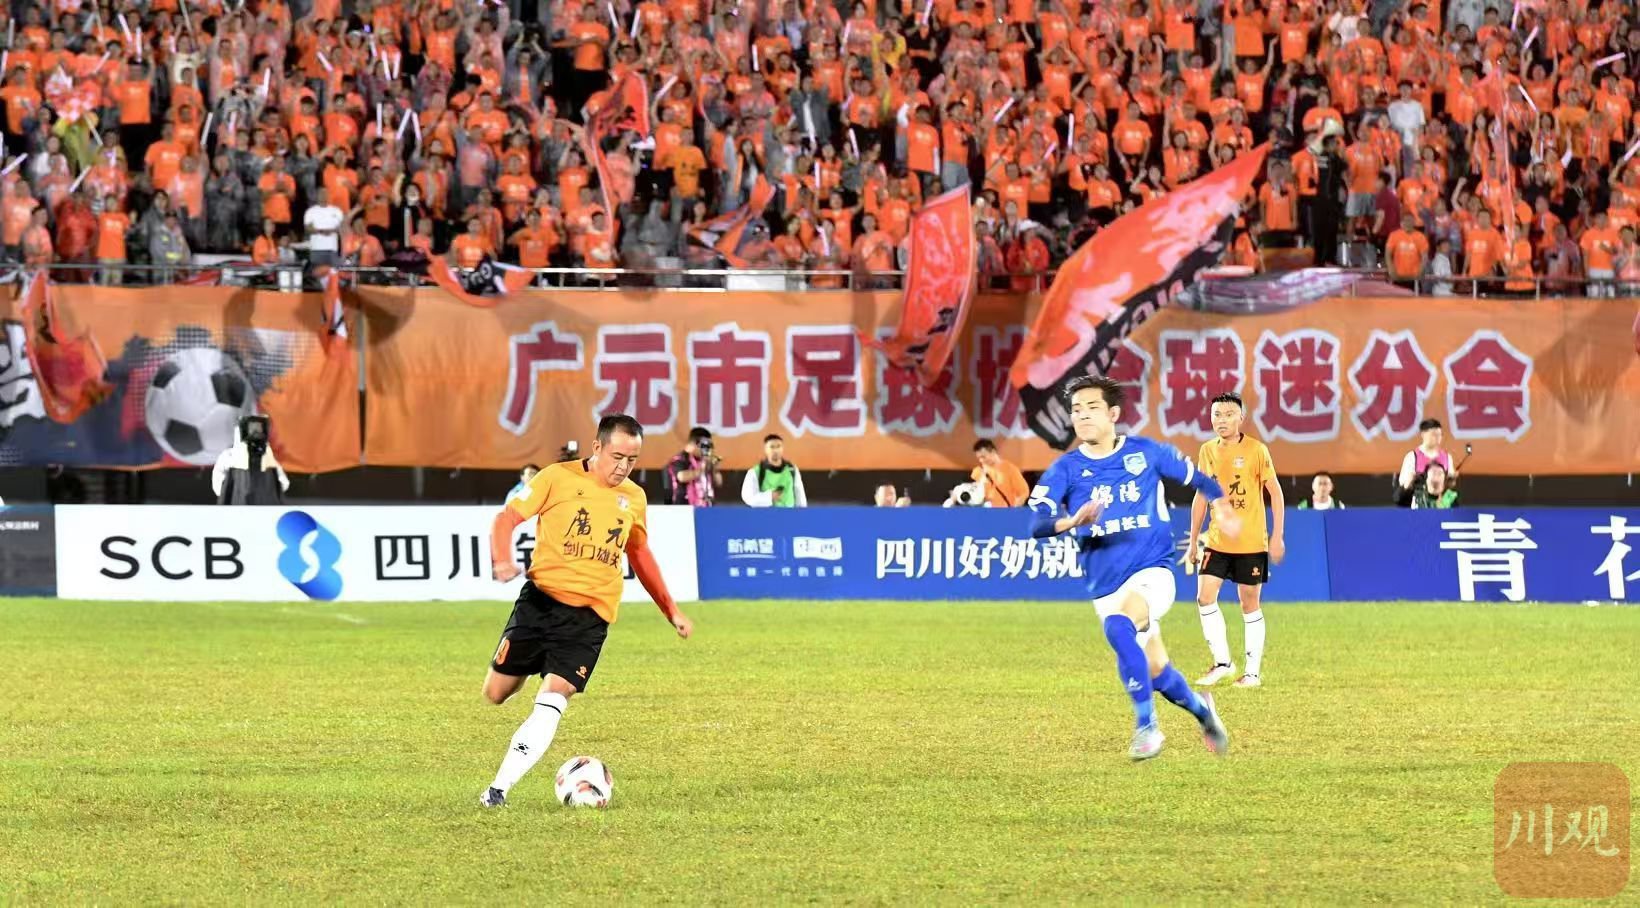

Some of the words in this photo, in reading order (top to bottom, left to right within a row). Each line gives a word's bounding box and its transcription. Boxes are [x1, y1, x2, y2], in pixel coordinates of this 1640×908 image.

[566, 507, 625, 549] 廣元
[100, 535, 244, 580] SCB
[563, 540, 619, 569] 剑门雄关
[876, 535, 1083, 579] 四川好奶就
